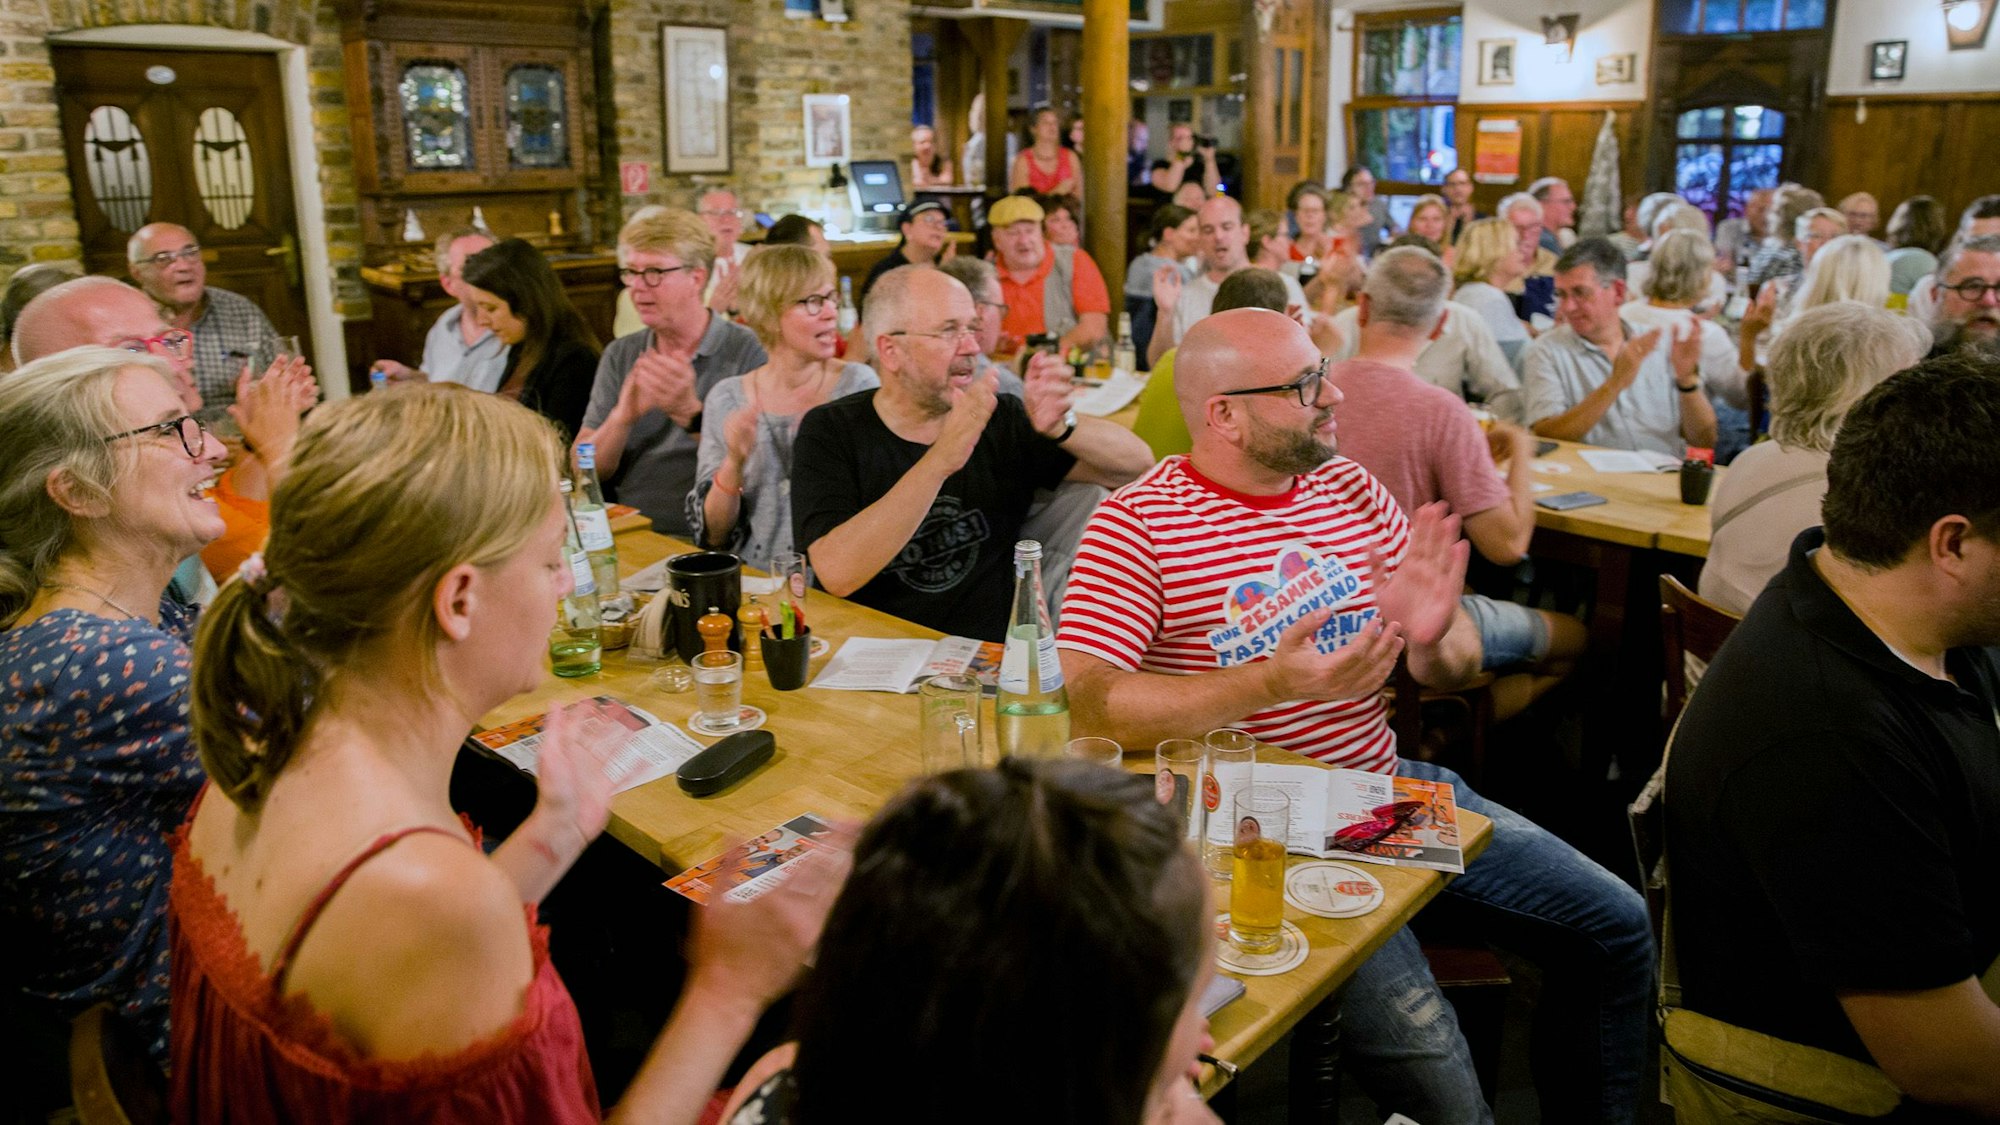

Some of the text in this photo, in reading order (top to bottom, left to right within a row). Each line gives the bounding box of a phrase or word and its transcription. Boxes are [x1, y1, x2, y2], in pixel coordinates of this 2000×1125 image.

[1322, 557, 1337, 572] SIN
[1210, 570, 1325, 647] NUR ZESAMME
